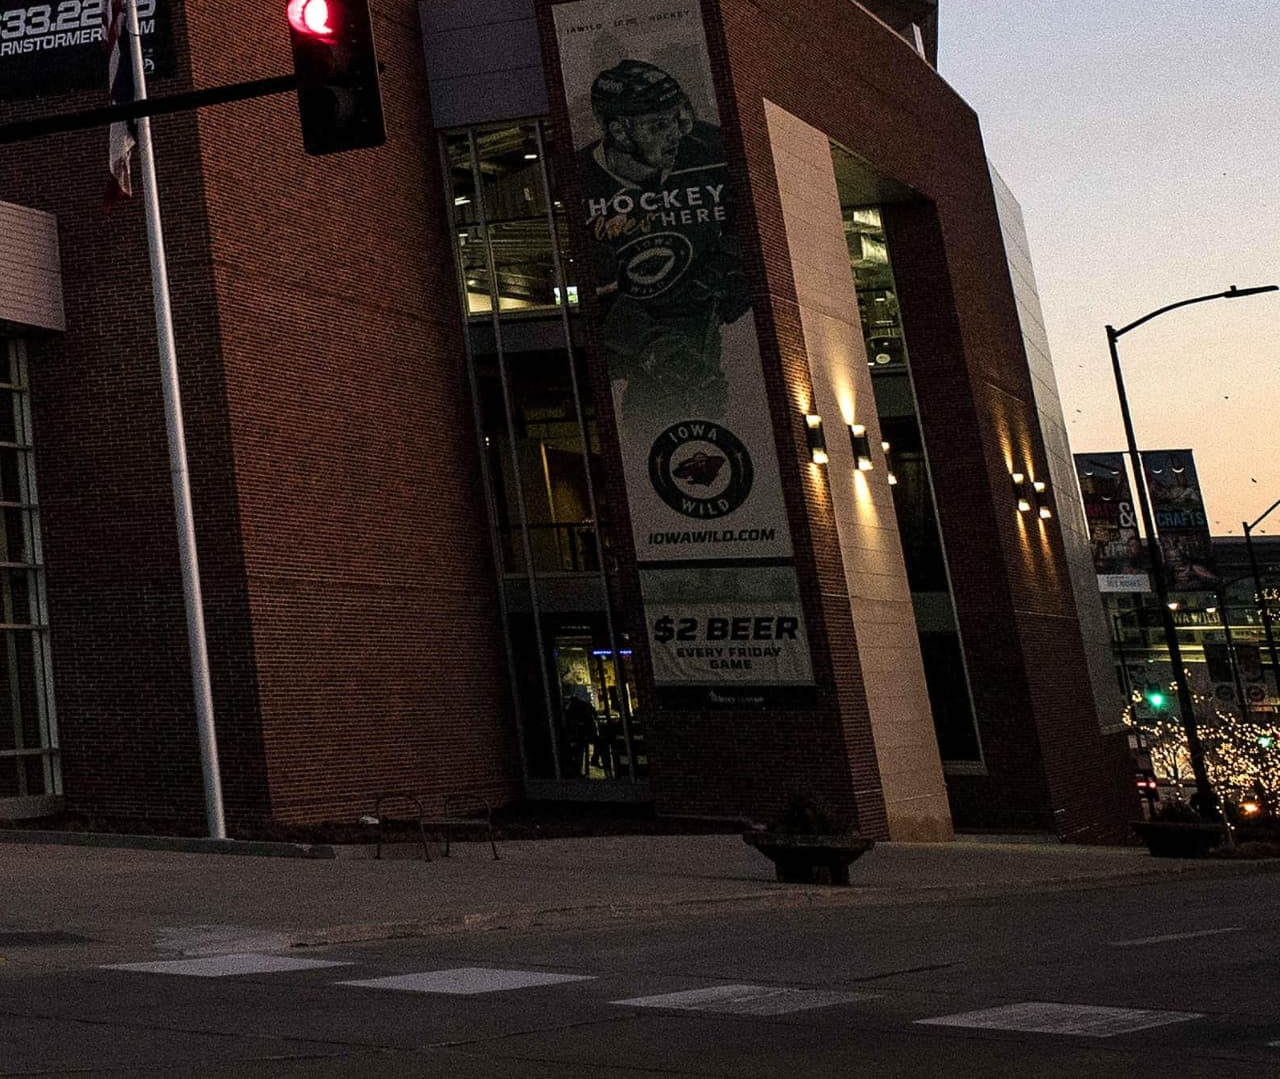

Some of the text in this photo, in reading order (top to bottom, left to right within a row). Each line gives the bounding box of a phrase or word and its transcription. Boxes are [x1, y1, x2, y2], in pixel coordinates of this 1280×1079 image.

[589, 184, 725, 216] HOCKEY
[661, 206, 727, 227] HERE
[668, 423, 719, 443] IOWA
[681, 497, 730, 516] WILD
[1118, 502, 1136, 528] &
[648, 528, 776, 545] IOWAWILD.COM
[654, 615, 799, 644] $2 BEER
[677, 646, 782, 658] EVERY FRIDAY
[710, 659, 753, 670] GAME
